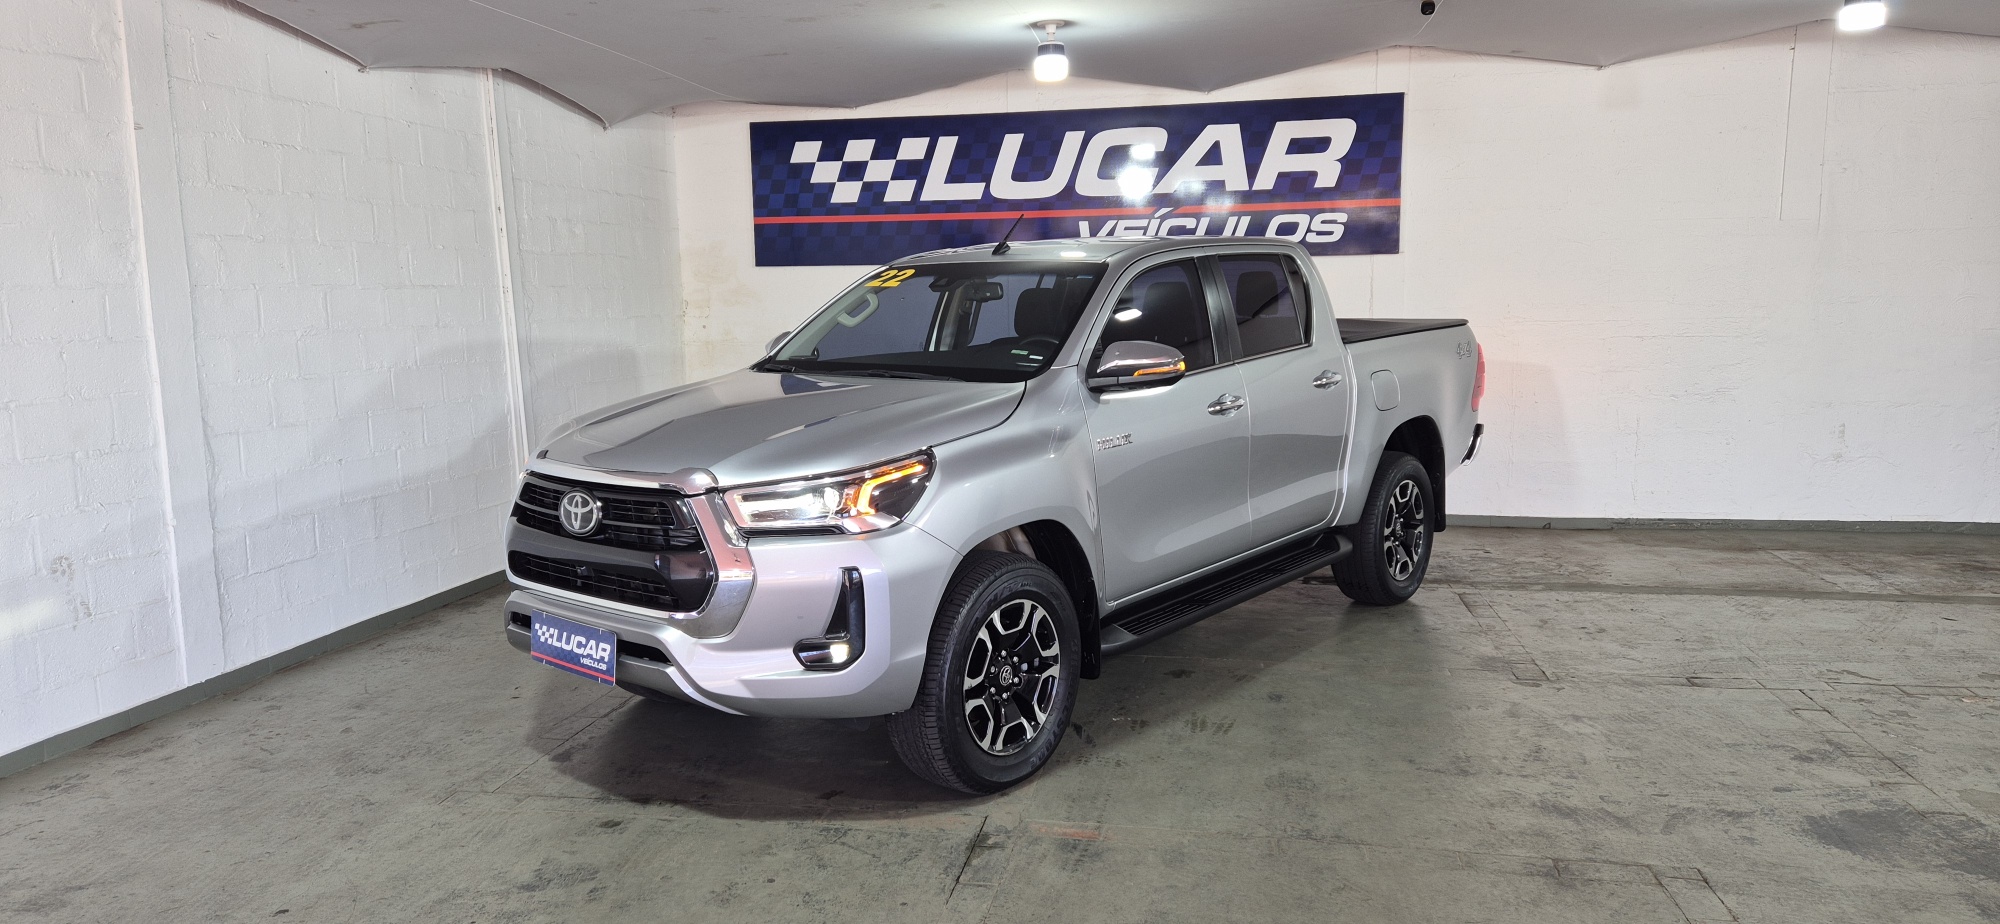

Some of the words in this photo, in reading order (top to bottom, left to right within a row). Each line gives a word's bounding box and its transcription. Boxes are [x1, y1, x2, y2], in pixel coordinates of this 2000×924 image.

[920, 117, 1357, 201] LUCAR
[864, 269, 916, 287] 22
[552, 629, 611, 662] LUCAR
[580, 657, 607, 671] VEÍCULOS
